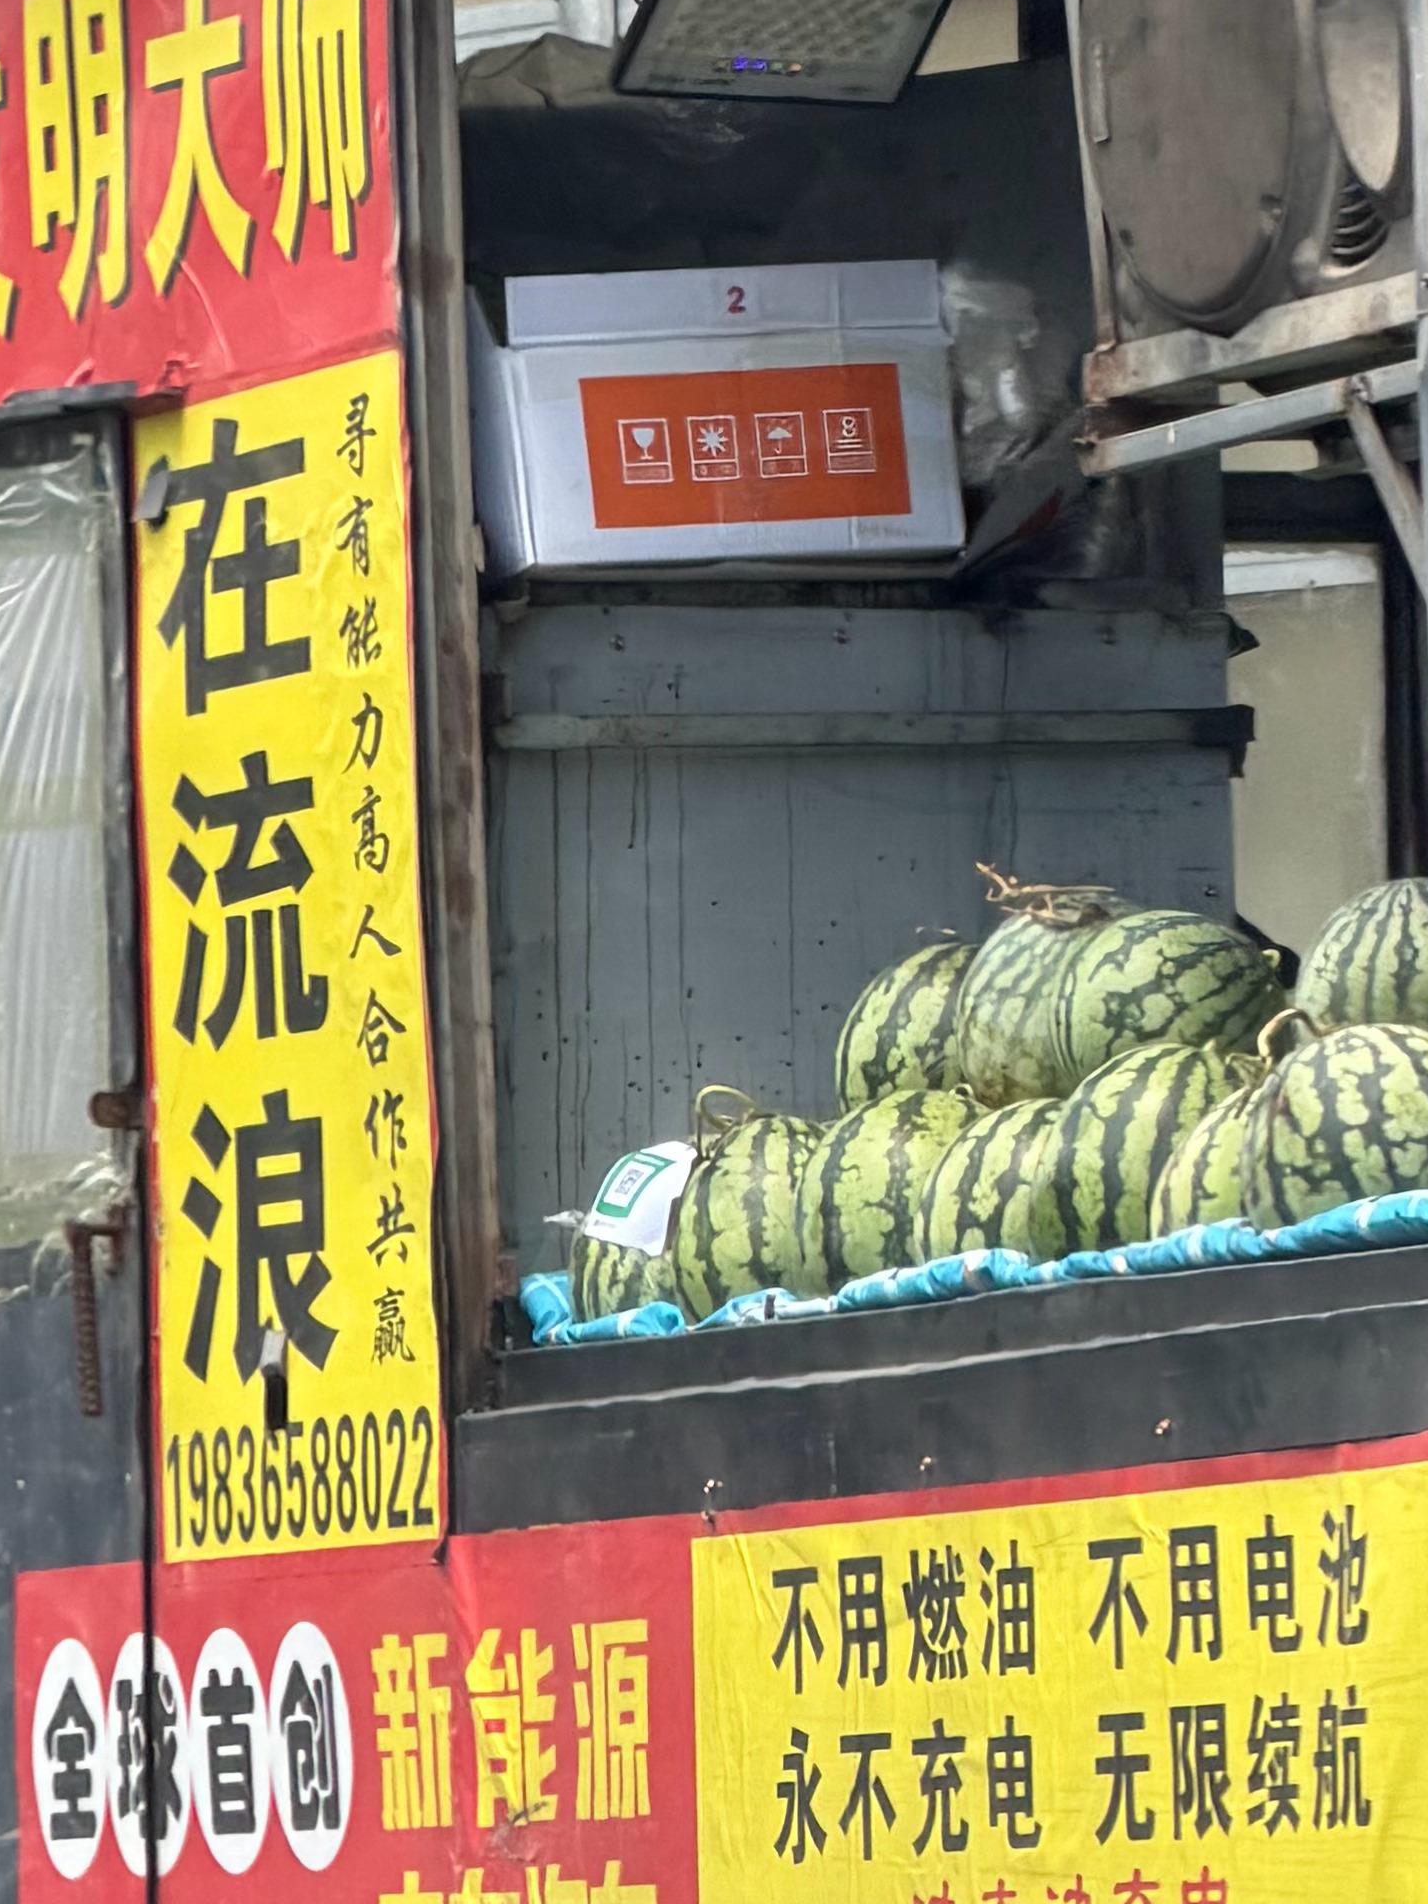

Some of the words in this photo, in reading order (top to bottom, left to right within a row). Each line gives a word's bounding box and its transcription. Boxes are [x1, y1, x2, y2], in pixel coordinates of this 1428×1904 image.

[727, 286, 746, 314] 2
[840, 416, 856, 438] 8
[156, 417, 340, 1384] 在流浪
[335, 392, 417, 1365] 寻有能力高人合作共赢
[167, 1406, 435, 1547] 19836588022
[772, 1538, 1037, 1694] 不用燃油
[1088, 1505, 1369, 1669] 不用电池
[45, 1660, 340, 1840] 全球首创
[371, 1619, 650, 1830] 新能源
[774, 1716, 1042, 1864] 永不充电
[1094, 1686, 1371, 1845] 无限续航
